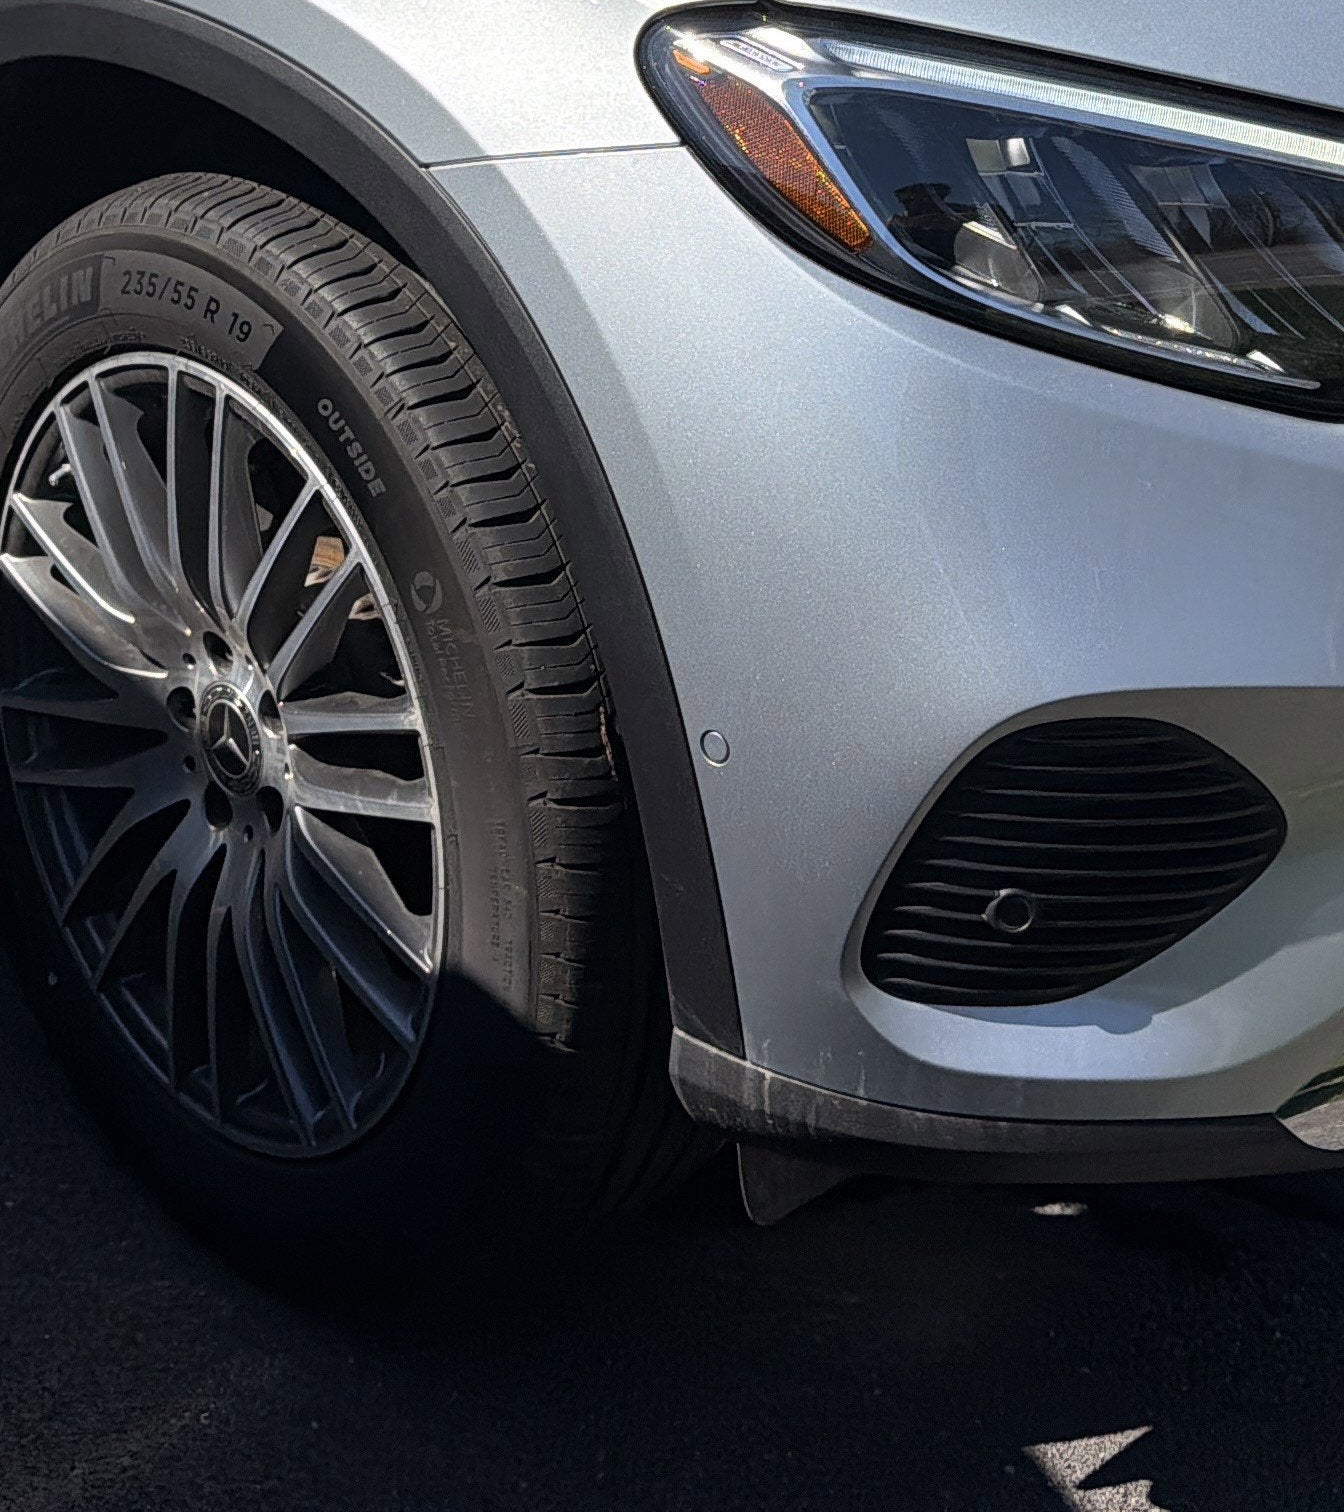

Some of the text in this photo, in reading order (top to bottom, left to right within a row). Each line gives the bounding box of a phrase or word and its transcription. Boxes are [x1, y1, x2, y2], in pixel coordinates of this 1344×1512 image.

[120, 269, 253, 343] 235/55 R 19
[317, 398, 387, 498] OUTSIDE
